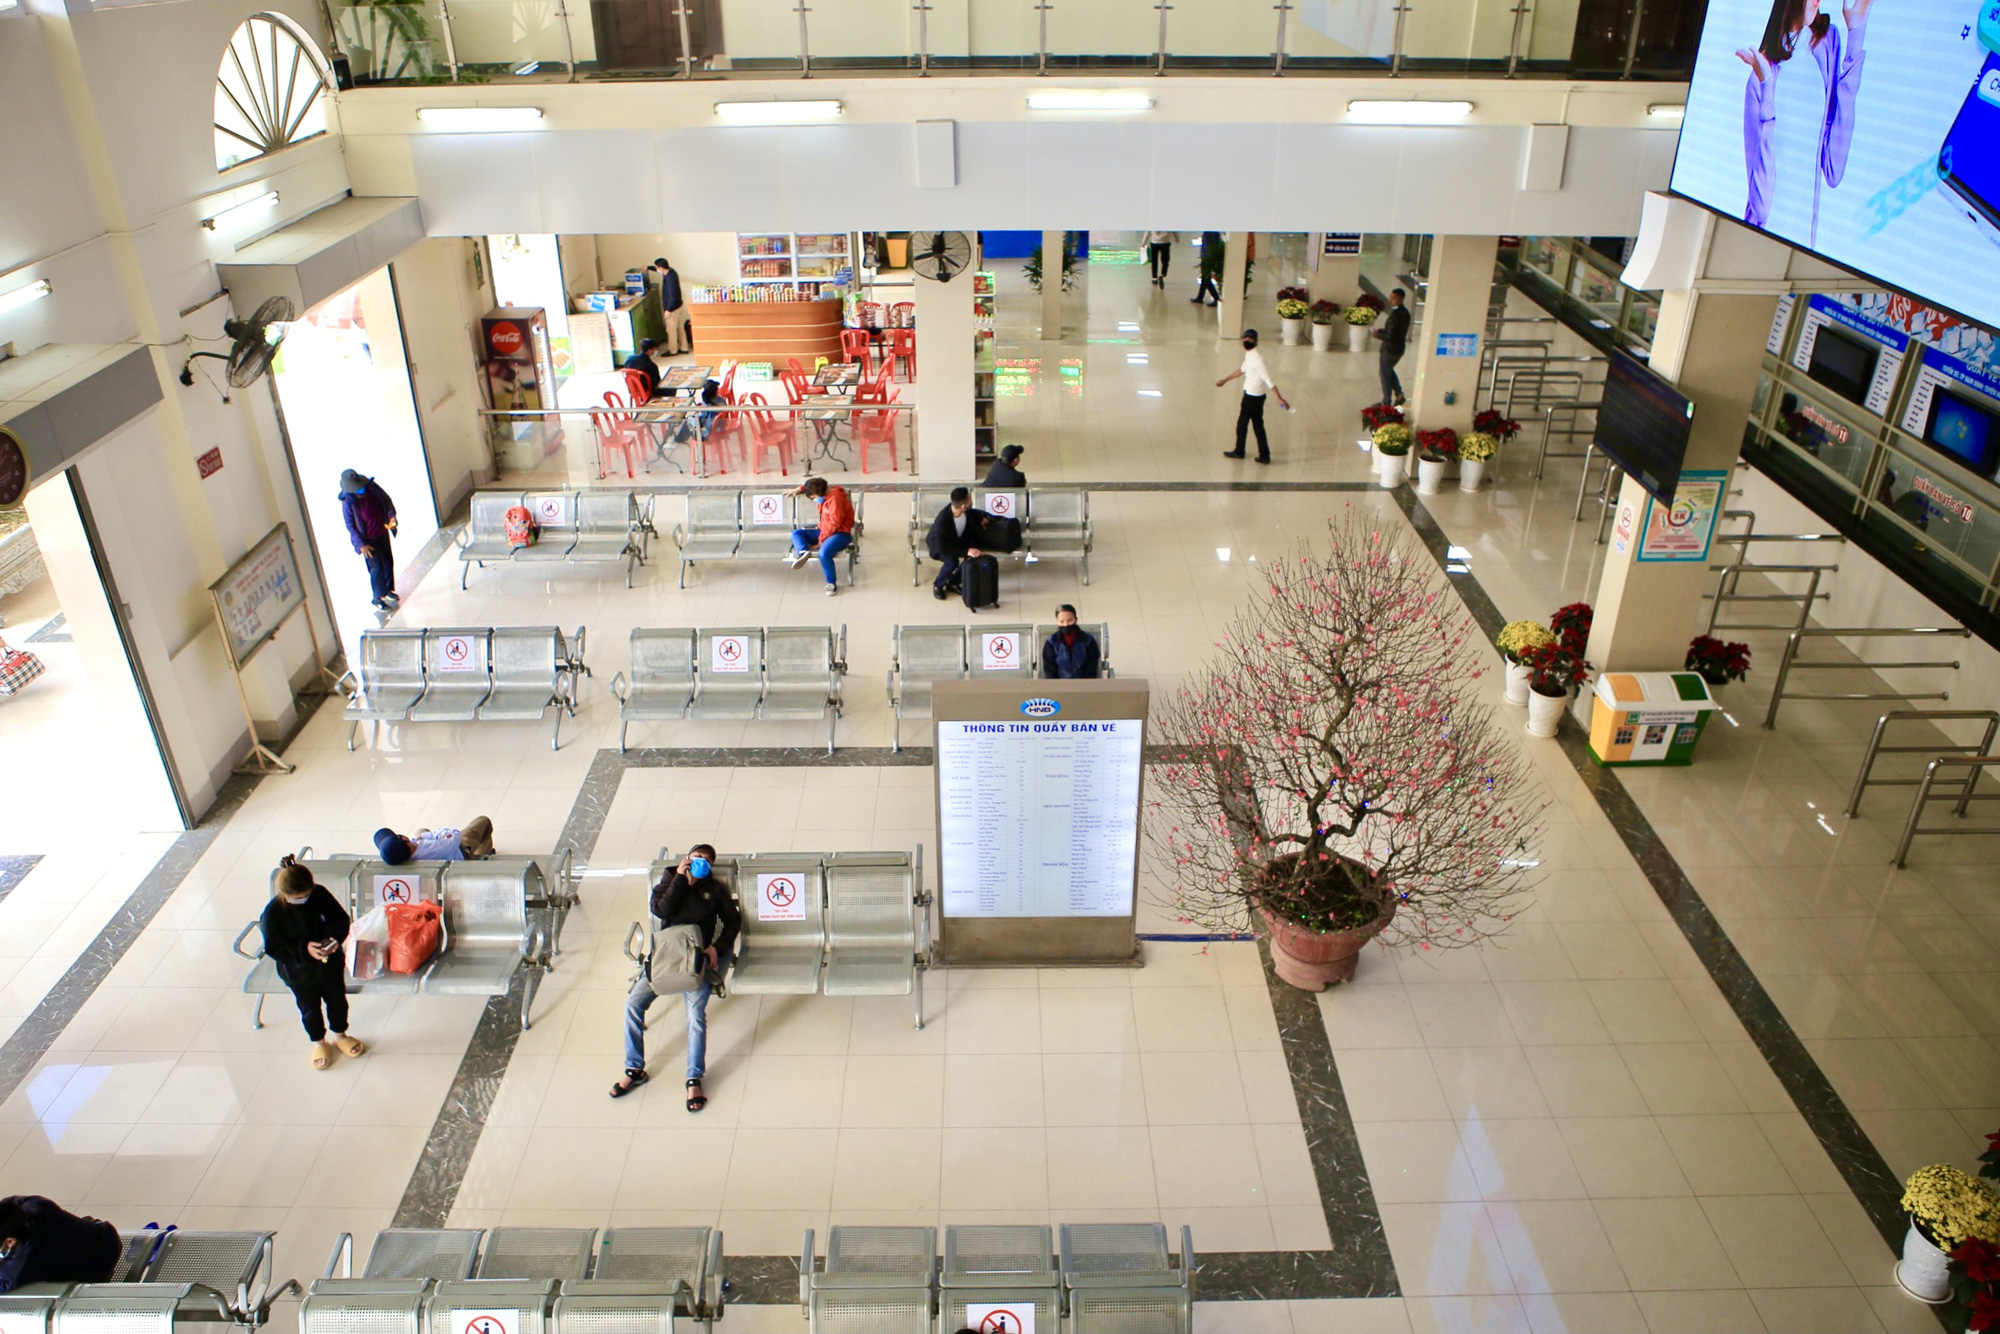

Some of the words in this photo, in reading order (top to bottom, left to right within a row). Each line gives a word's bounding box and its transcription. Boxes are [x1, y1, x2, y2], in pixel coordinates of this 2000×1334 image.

[492, 332, 520, 343] Coca-Cola
[1961, 506, 1973, 521] 10
[962, 723, 1005, 733] THÔNG
[1009, 724, 1029, 732] TIN
[1071, 722, 1097, 732] BÁN
[1102, 722, 1117, 732] VÉ
